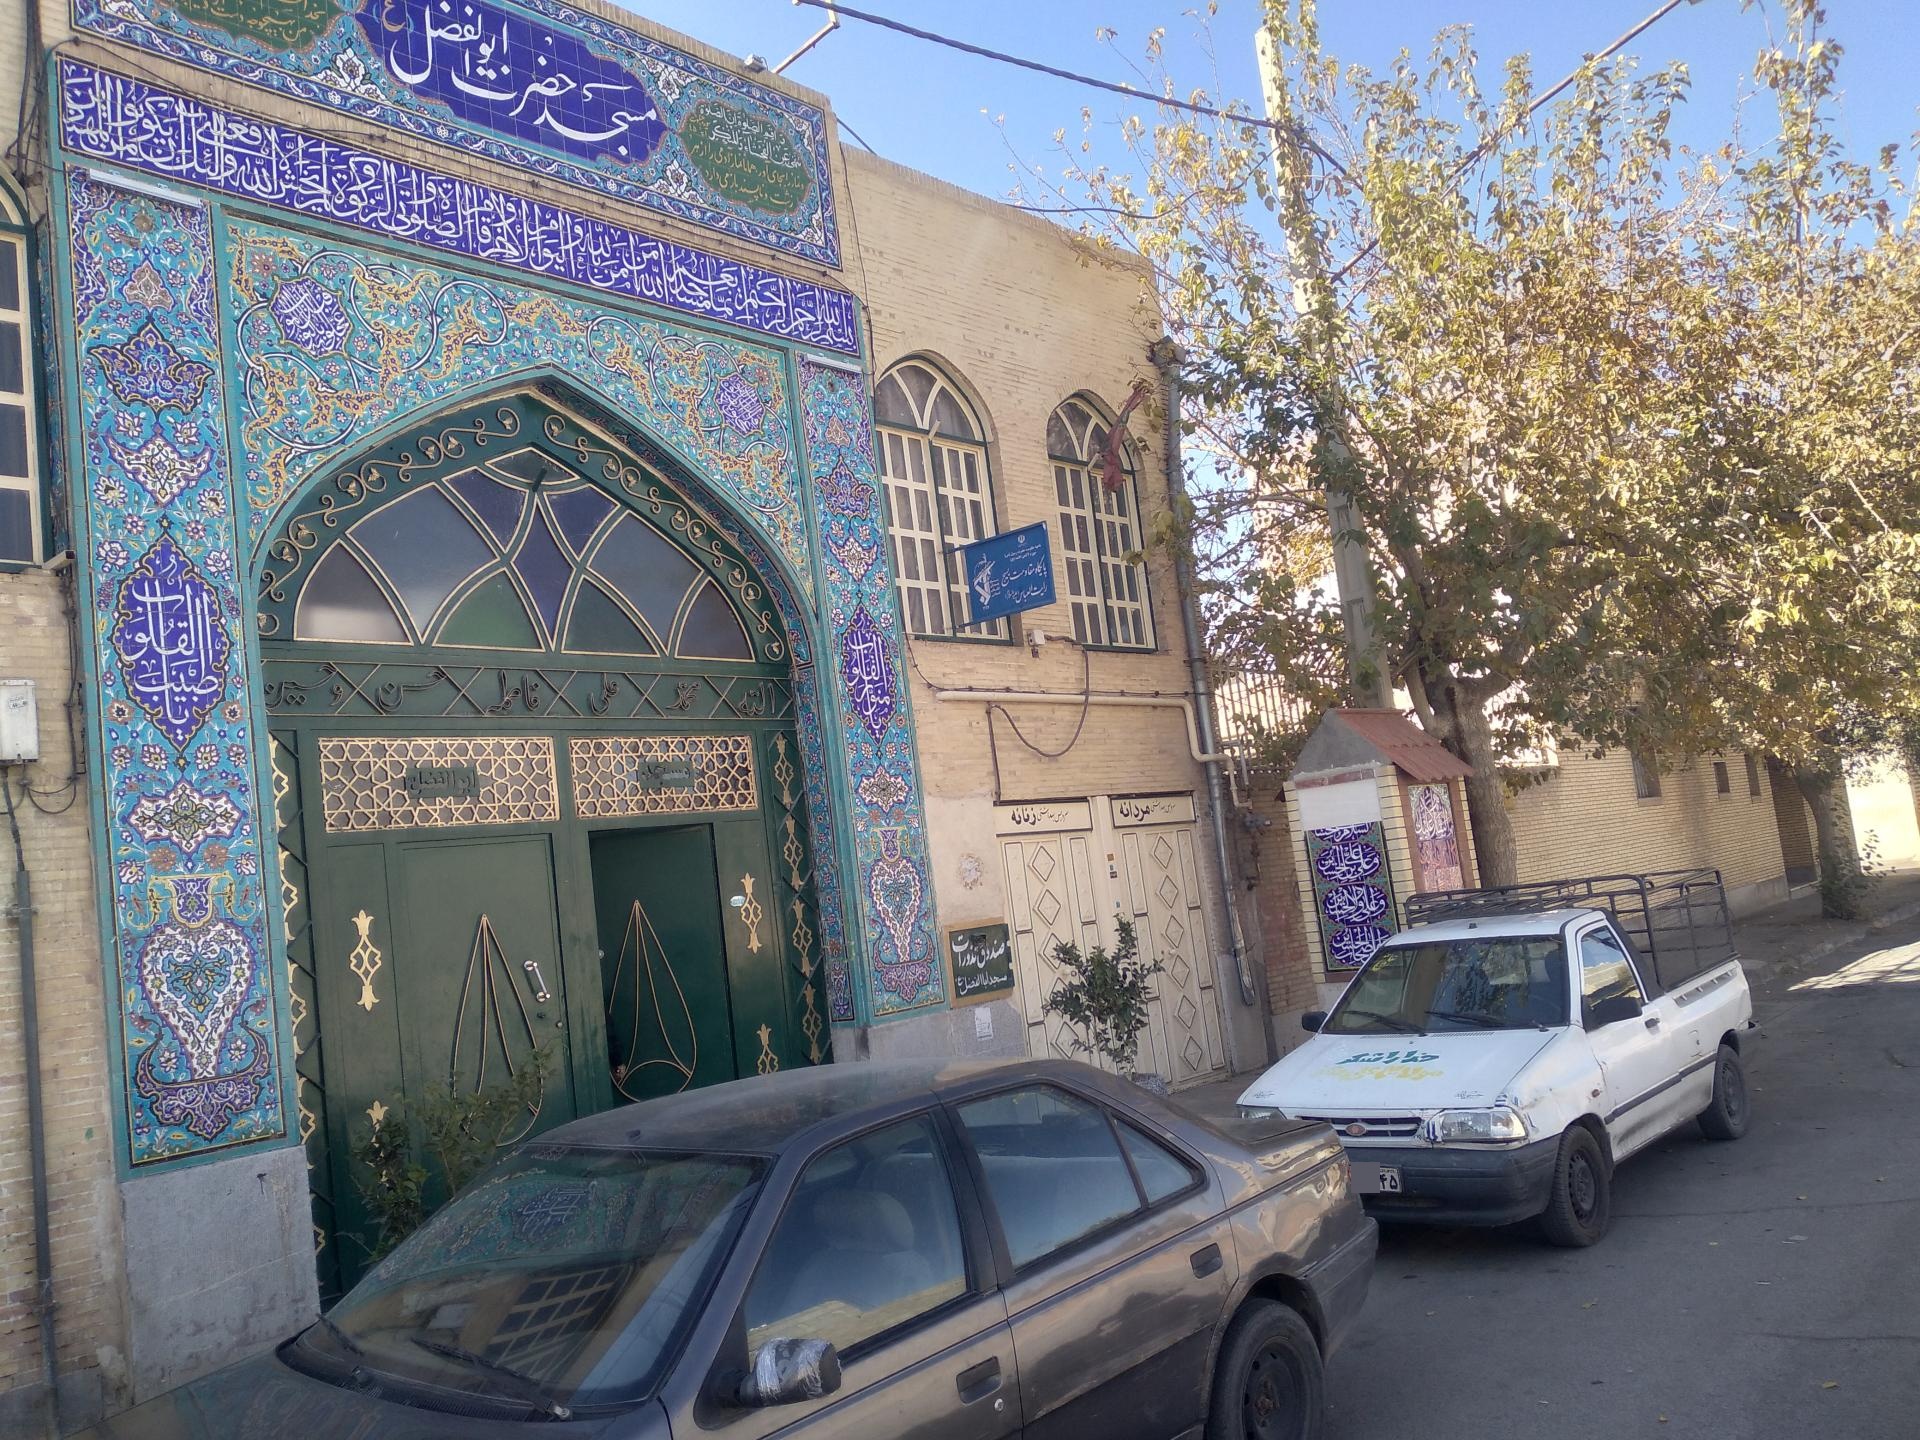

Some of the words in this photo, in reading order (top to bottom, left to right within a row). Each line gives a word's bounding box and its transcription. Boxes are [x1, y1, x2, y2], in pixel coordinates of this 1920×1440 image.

[452, 55, 577, 117] حضرت
[533, 98, 657, 156] مسجد
[1012, 806, 1036, 825] زنانه
[1120, 801, 1150, 821] مردانه
[952, 935, 977, 967] نذورات
[976, 940, 1005, 968] صندوق
[989, 975, 1007, 988] مسجد
